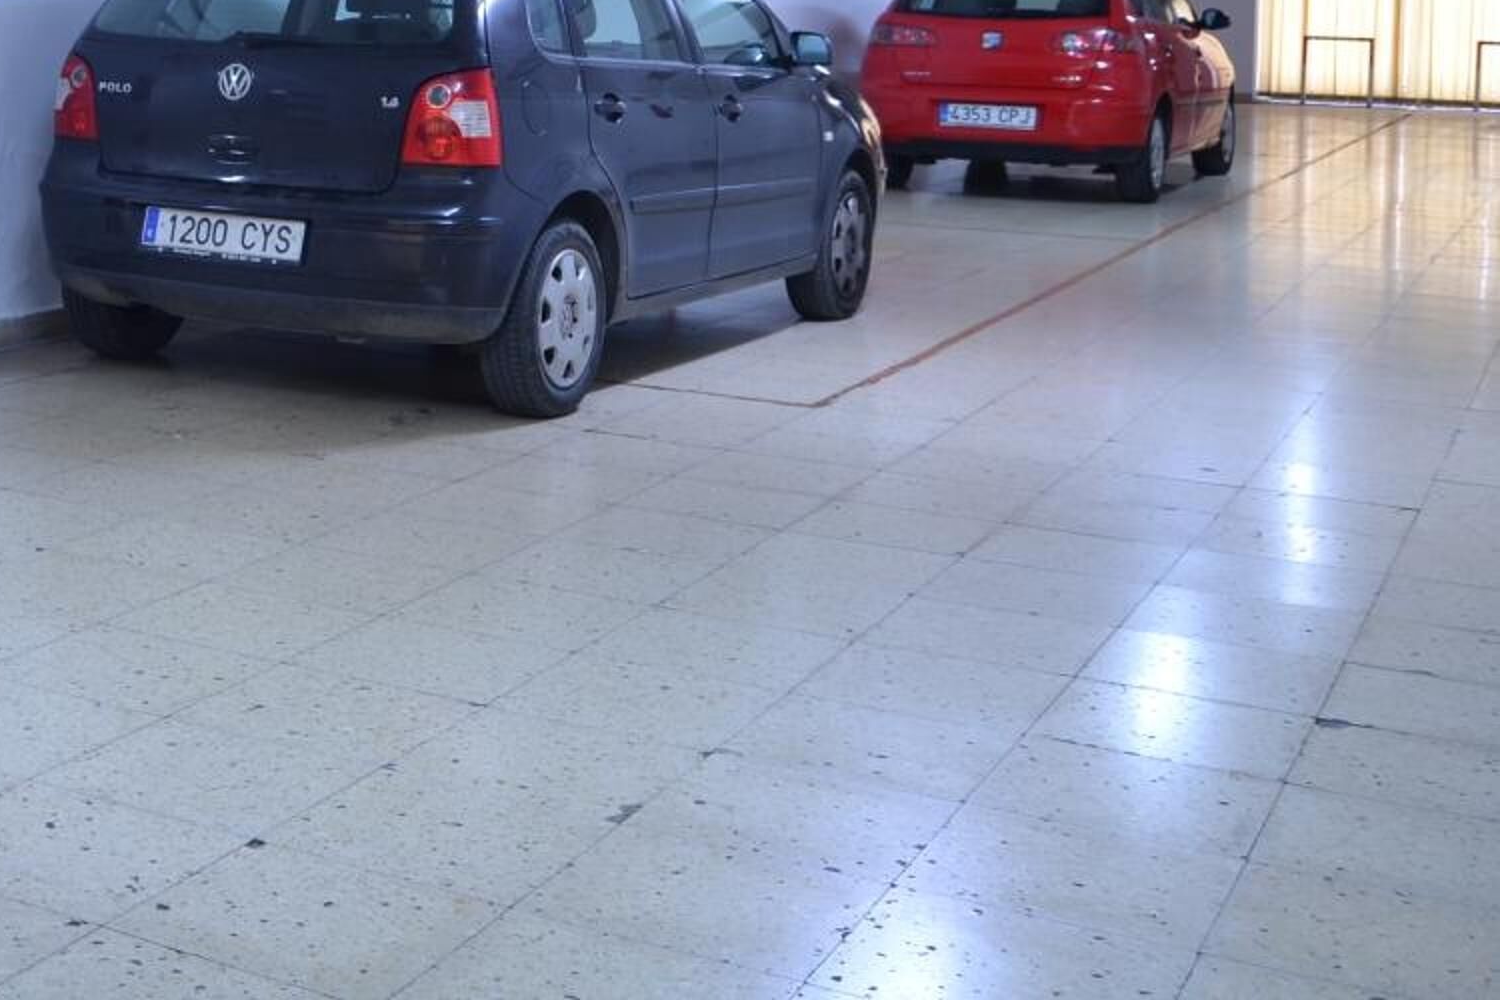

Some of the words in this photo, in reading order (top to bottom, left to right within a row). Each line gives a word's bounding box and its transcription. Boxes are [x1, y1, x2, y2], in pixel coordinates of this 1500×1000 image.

[98, 81, 132, 94] POLO
[950, 106, 991, 122] 4353
[169, 213, 228, 247] 1200
[241, 221, 292, 254] CYS
